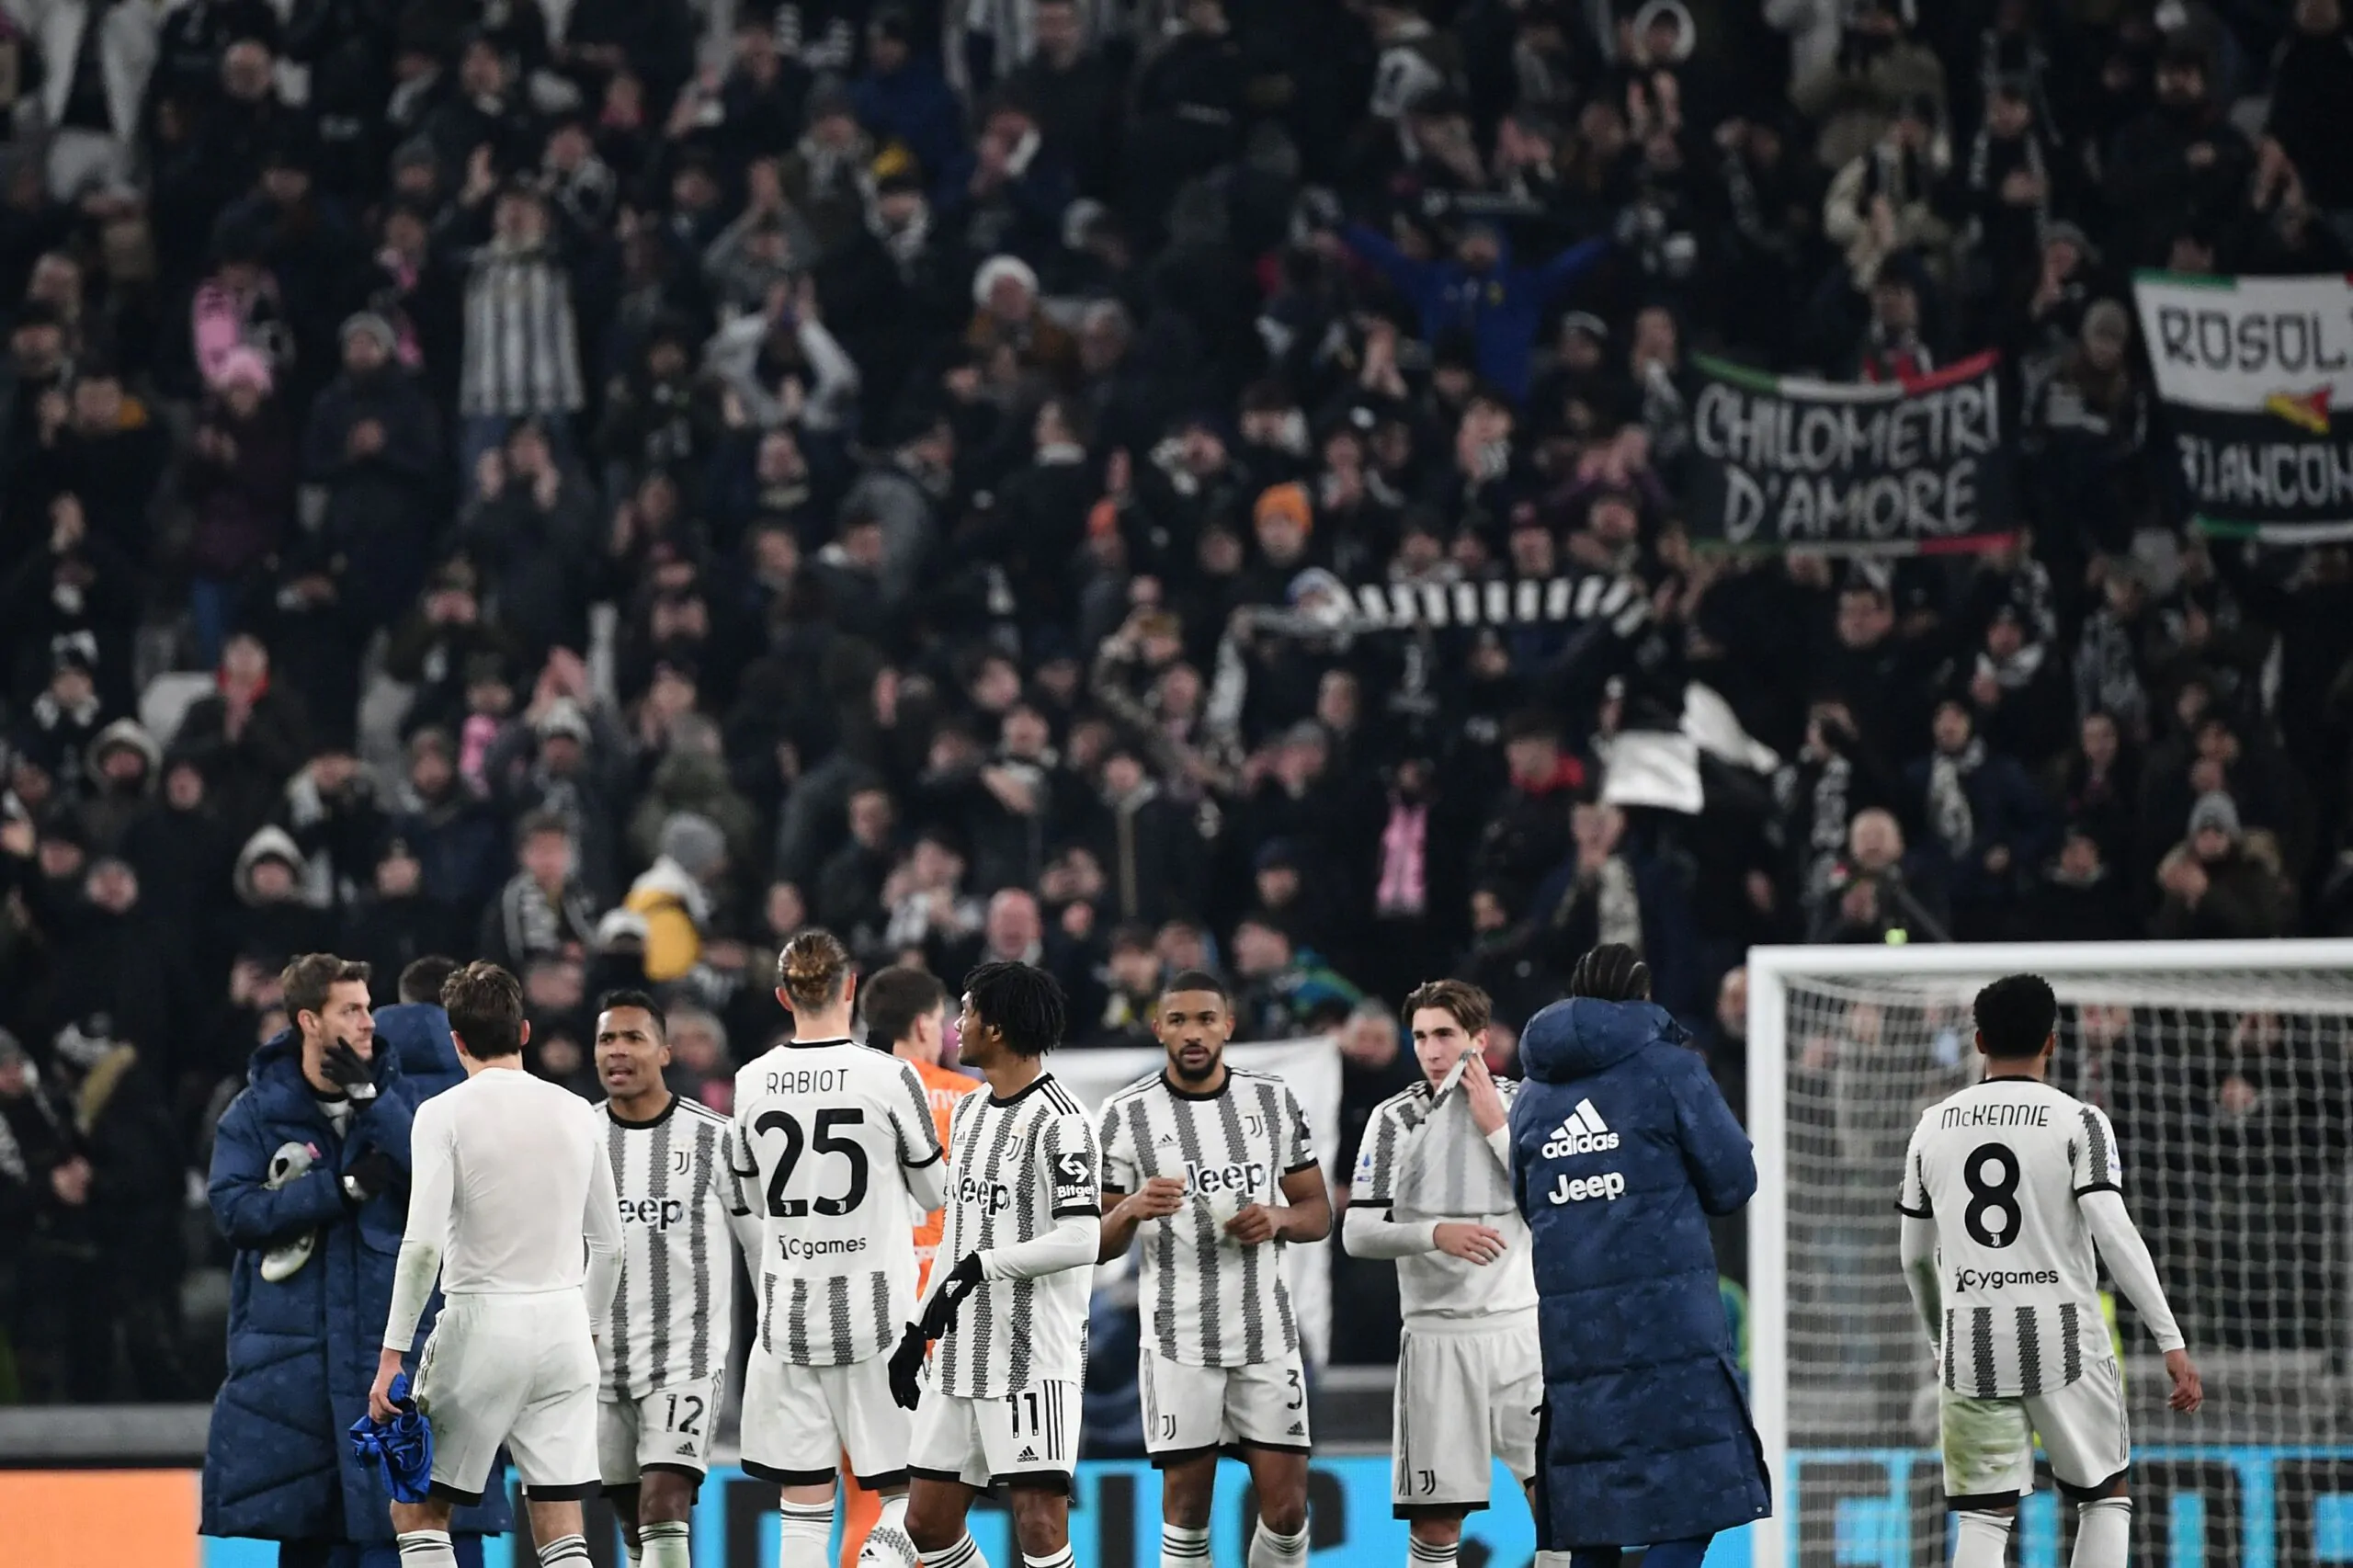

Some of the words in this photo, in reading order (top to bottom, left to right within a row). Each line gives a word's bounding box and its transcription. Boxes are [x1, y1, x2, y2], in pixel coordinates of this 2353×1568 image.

[2157, 305, 2353, 372] ROSOL
[1696, 373, 2000, 472] CHILOMETRI
[1724, 459, 1978, 544] D'AMORE
[767, 1069, 849, 1095] RABIOT
[1941, 1105, 2051, 1130] McKENNIE
[754, 1108, 869, 1218] 25
[1541, 1132, 1620, 1159] adidas
[952, 1165, 1010, 1216] Jeep
[1057, 1184, 1097, 1199] Bitget
[1183, 1162, 1267, 1196] Jeep
[1548, 1172, 1625, 1205] Jeep
[1963, 1142, 2022, 1249] 8
[618, 1199, 684, 1231] eep
[789, 1237, 867, 1260] Cgames
[1962, 1268, 2060, 1290] Cygames
[1287, 1369, 1302, 1410] 3
[665, 1392, 704, 1437] 12
[1006, 1392, 1040, 1439] 11
